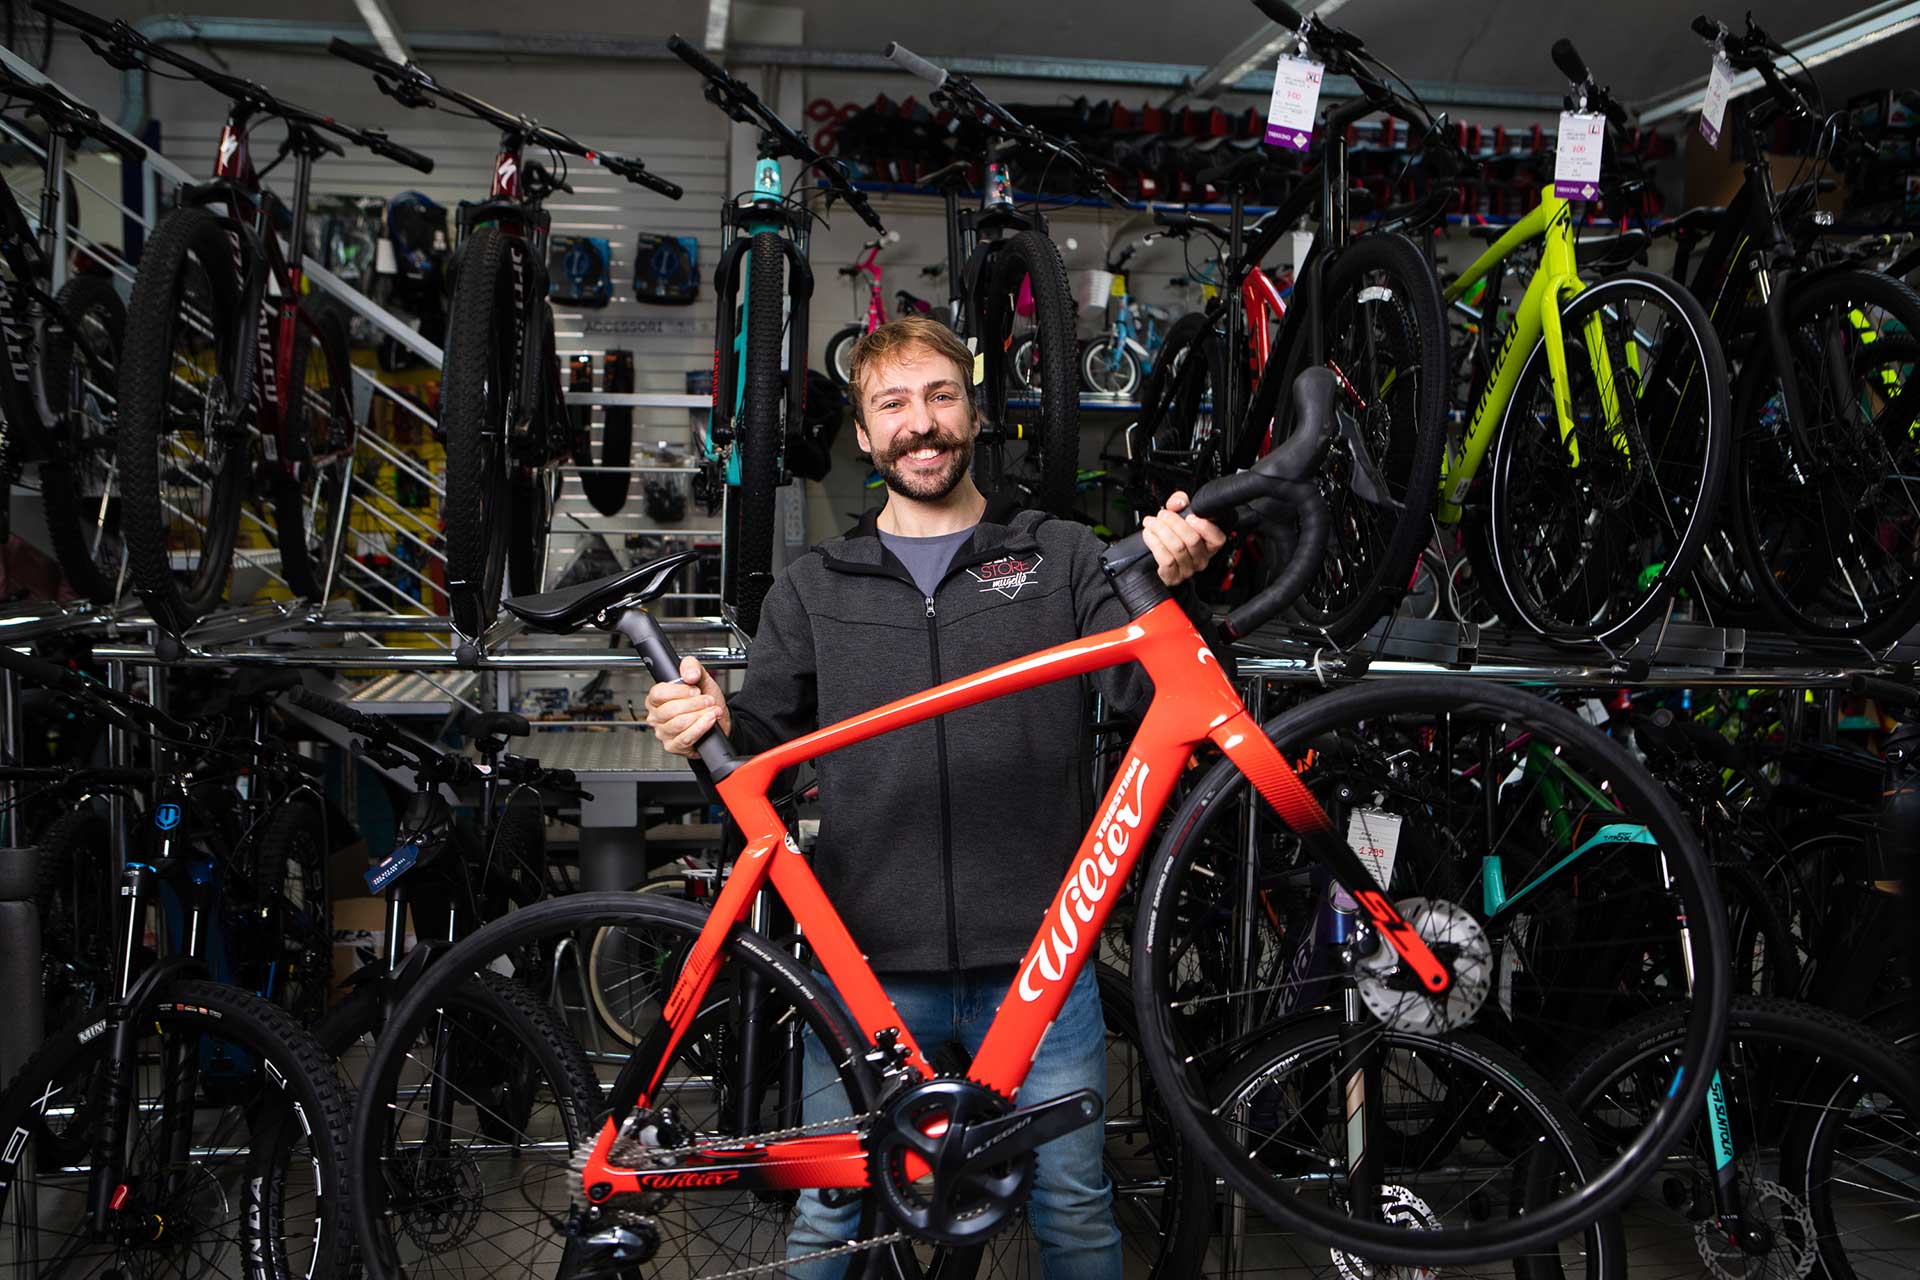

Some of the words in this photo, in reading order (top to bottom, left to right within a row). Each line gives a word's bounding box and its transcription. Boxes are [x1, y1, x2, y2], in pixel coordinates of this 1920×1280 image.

[584, 320, 663, 333] ACCESSORI
[980, 559, 1032, 580] STORE
[1095, 756, 1141, 839] TRIESTINA
[1018, 762, 1151, 1003] Wilier
[740, 939, 773, 963] vittoria
[799, 984, 815, 1000] PRO
[966, 1116, 1033, 1159] ULTEGRA
[1713, 1104, 1733, 1157] SUNTOUR
[641, 1170, 740, 1189] Wilier
